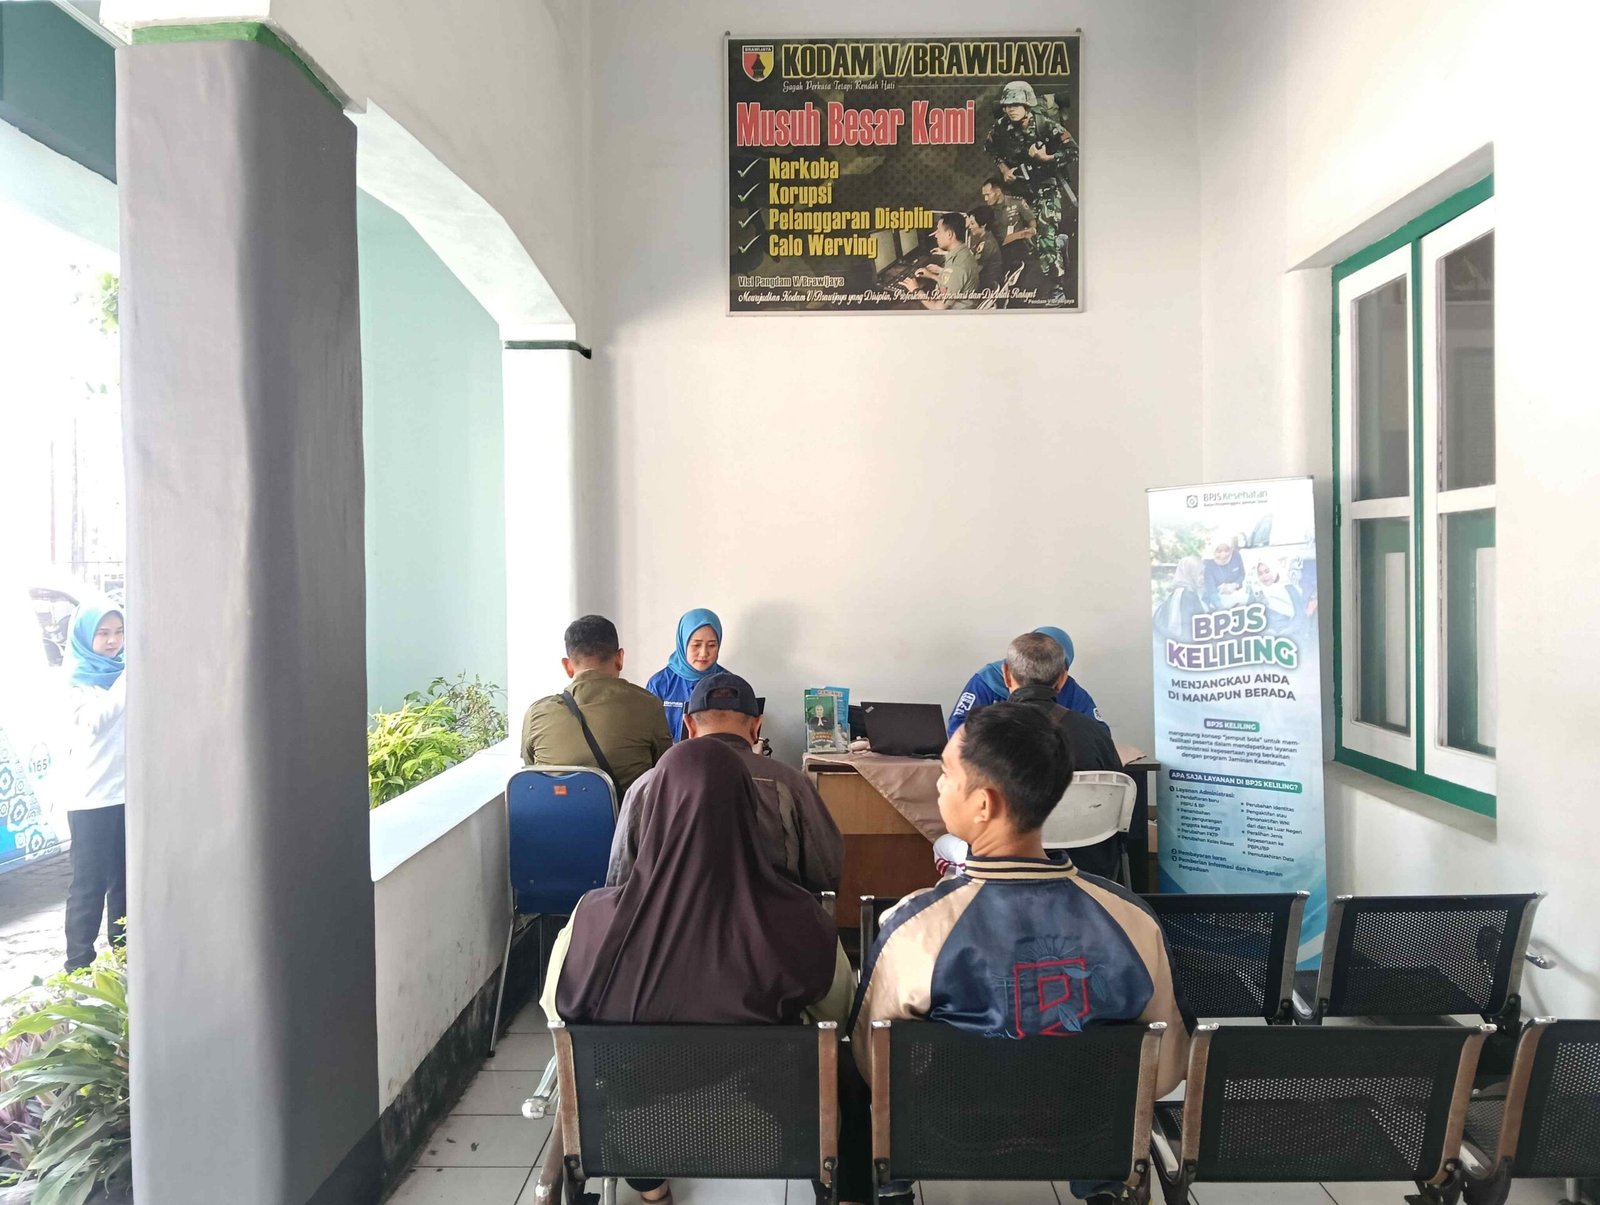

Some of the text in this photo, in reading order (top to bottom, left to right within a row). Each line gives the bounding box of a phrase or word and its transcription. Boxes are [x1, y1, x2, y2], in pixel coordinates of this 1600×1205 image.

[782, 42, 1070, 78] KODAM V/BRAWIJAYA
[783, 80, 895, 92] Gagah Perkasa Tetapi Rendah Hati
[737, 100, 975, 146] Musuh Besar Kami
[769, 157, 839, 180] Narkoba
[769, 183, 832, 207] Korupsi
[769, 207, 934, 233] Pelanggaran Disiplin
[769, 234, 878, 259] Calo Werving
[738, 276, 754, 287] Visi
[755, 276, 791, 288] Pangdam
[782, 291, 805, 301] Kodam
[848, 294, 863, 305] yang
[1203, 492, 1221, 501] BPJS
[1193, 605, 1266, 641] BPJS
[1167, 638, 1297, 669] KELILING
[1171, 674, 1290, 689] MENJANGKAU ANDA
[1168, 688, 1296, 702] DI MANAPUN BERADA
[1225, 722, 1256, 730] KELILING
[1169, 730, 1200, 738] mengusung
[1182, 752, 1202, 760] dengan
[33, 758, 47, 773] 165
[1204, 774, 1235, 784] LAYANAN
[1264, 781, 1298, 791] KELILING?
